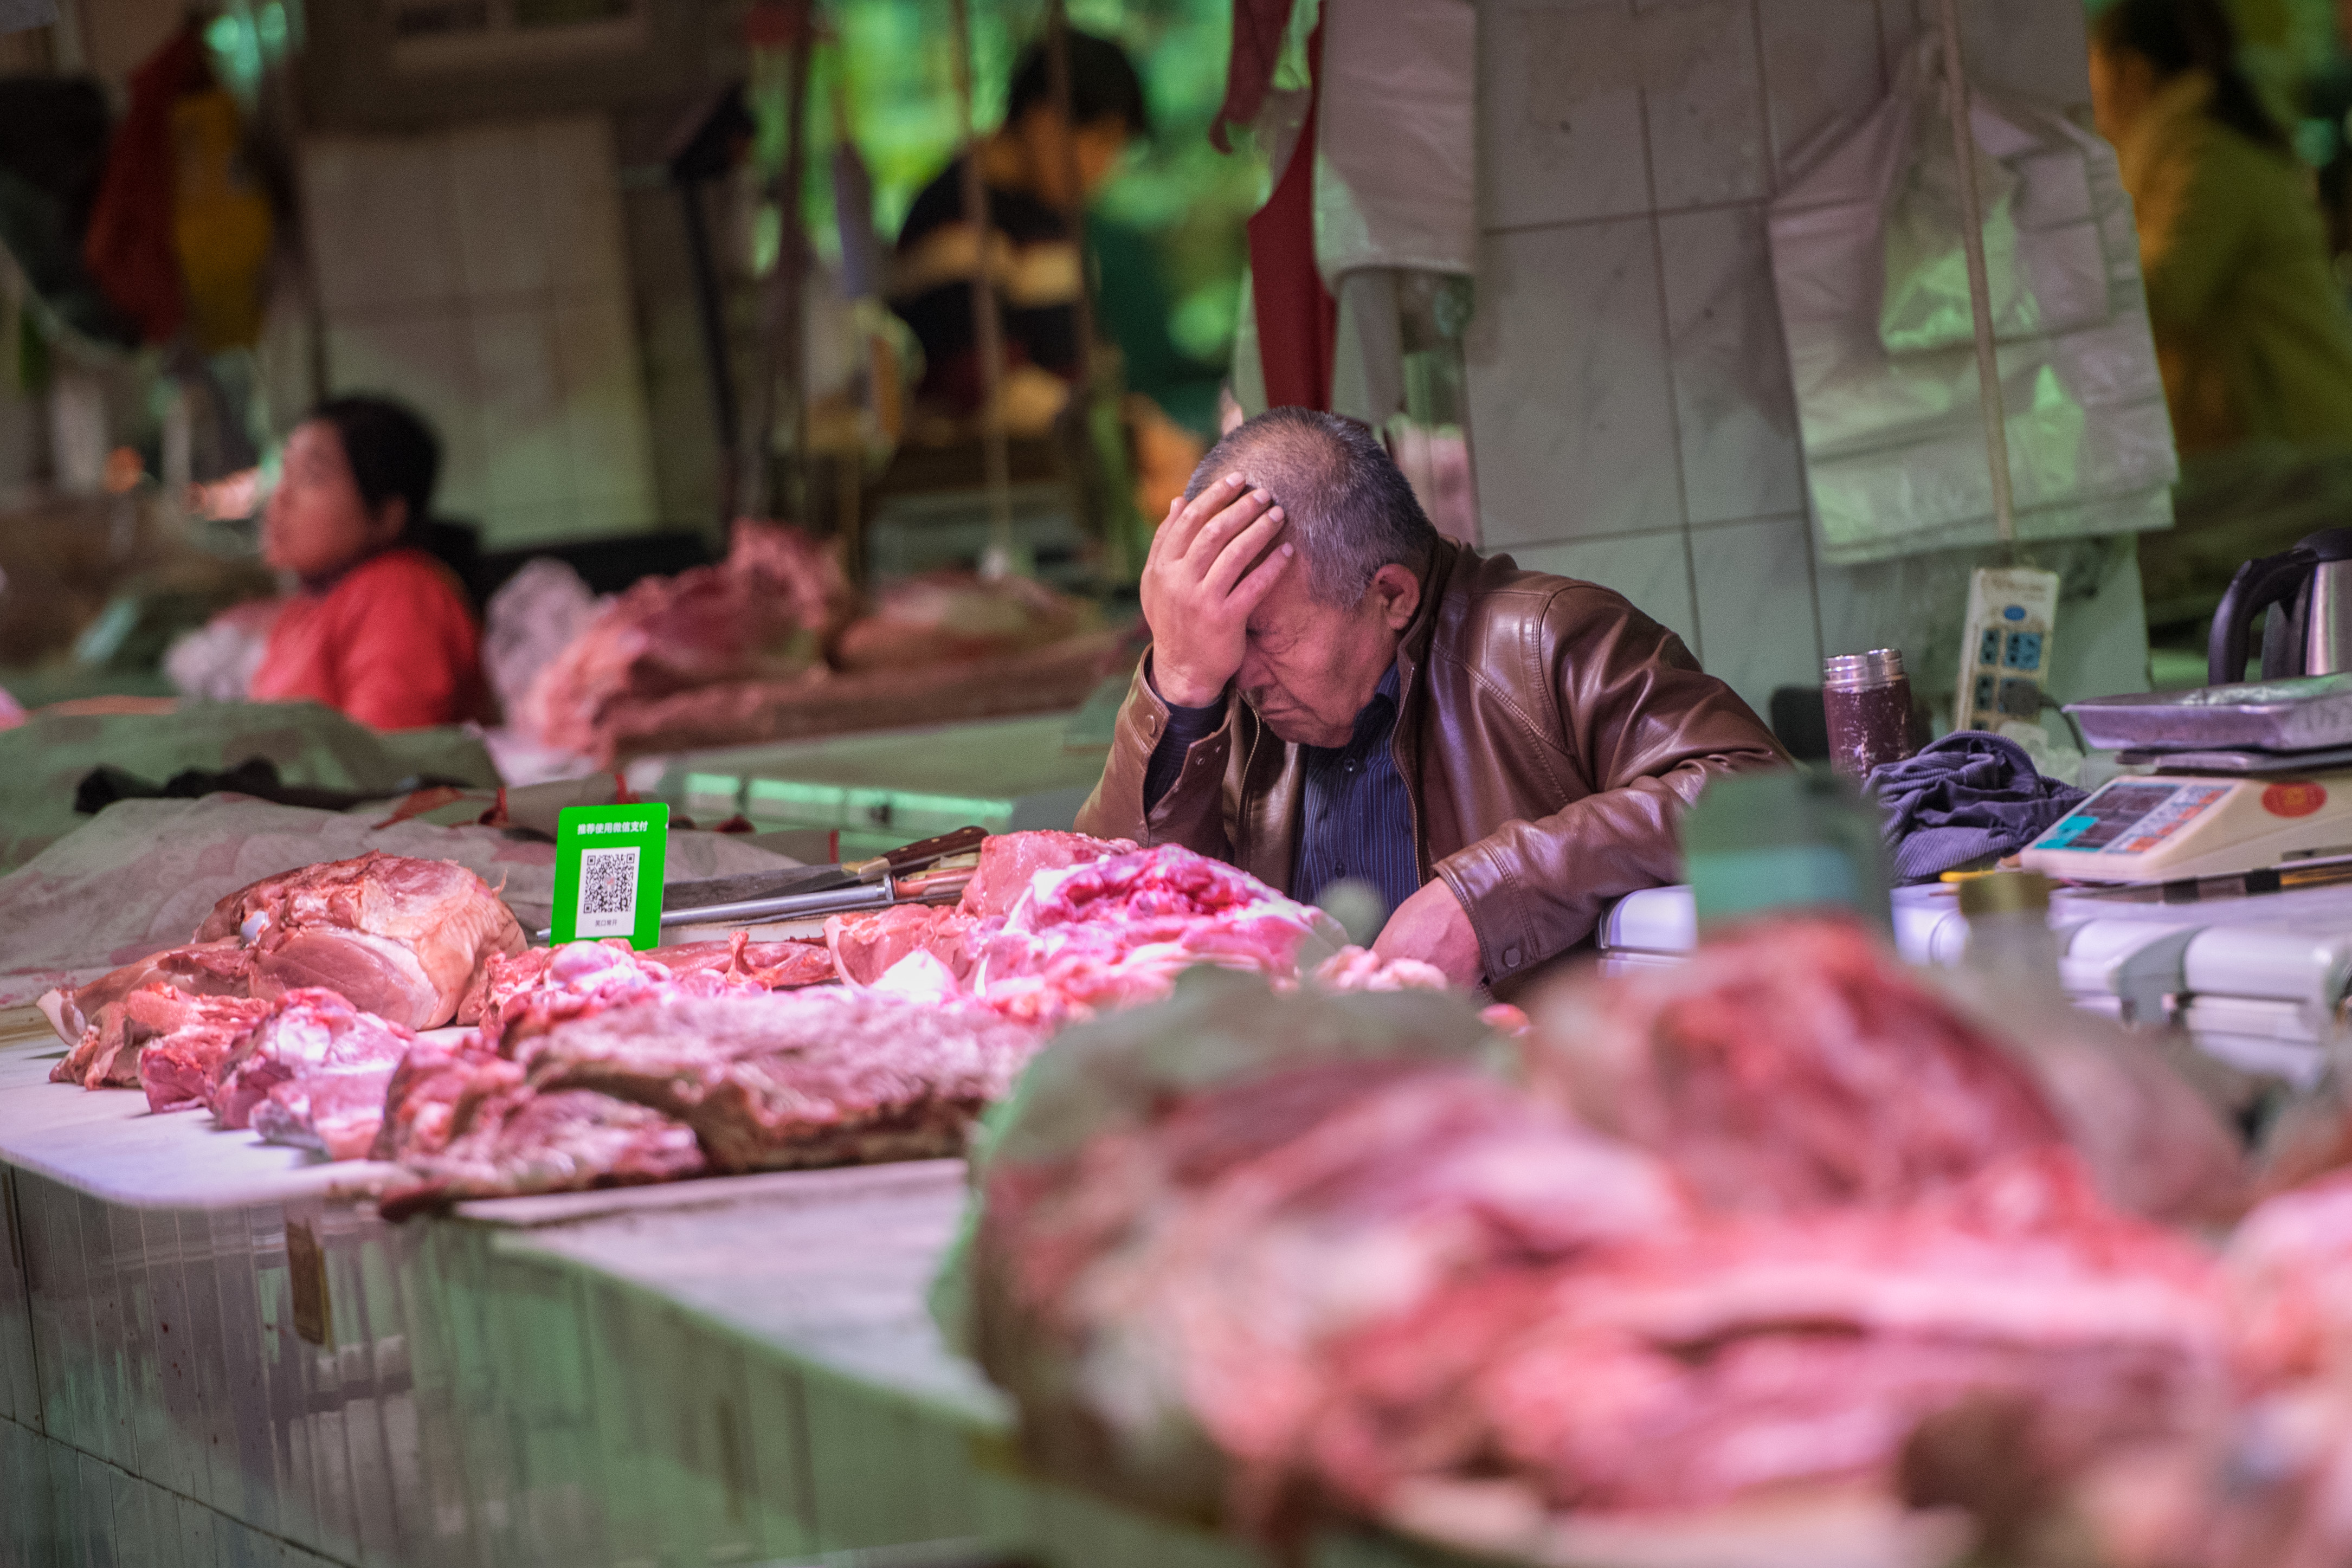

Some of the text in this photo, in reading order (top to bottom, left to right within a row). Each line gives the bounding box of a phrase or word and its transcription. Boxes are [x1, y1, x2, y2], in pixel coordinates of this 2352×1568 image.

[577, 821, 648, 835] 推荐使用微信支付
